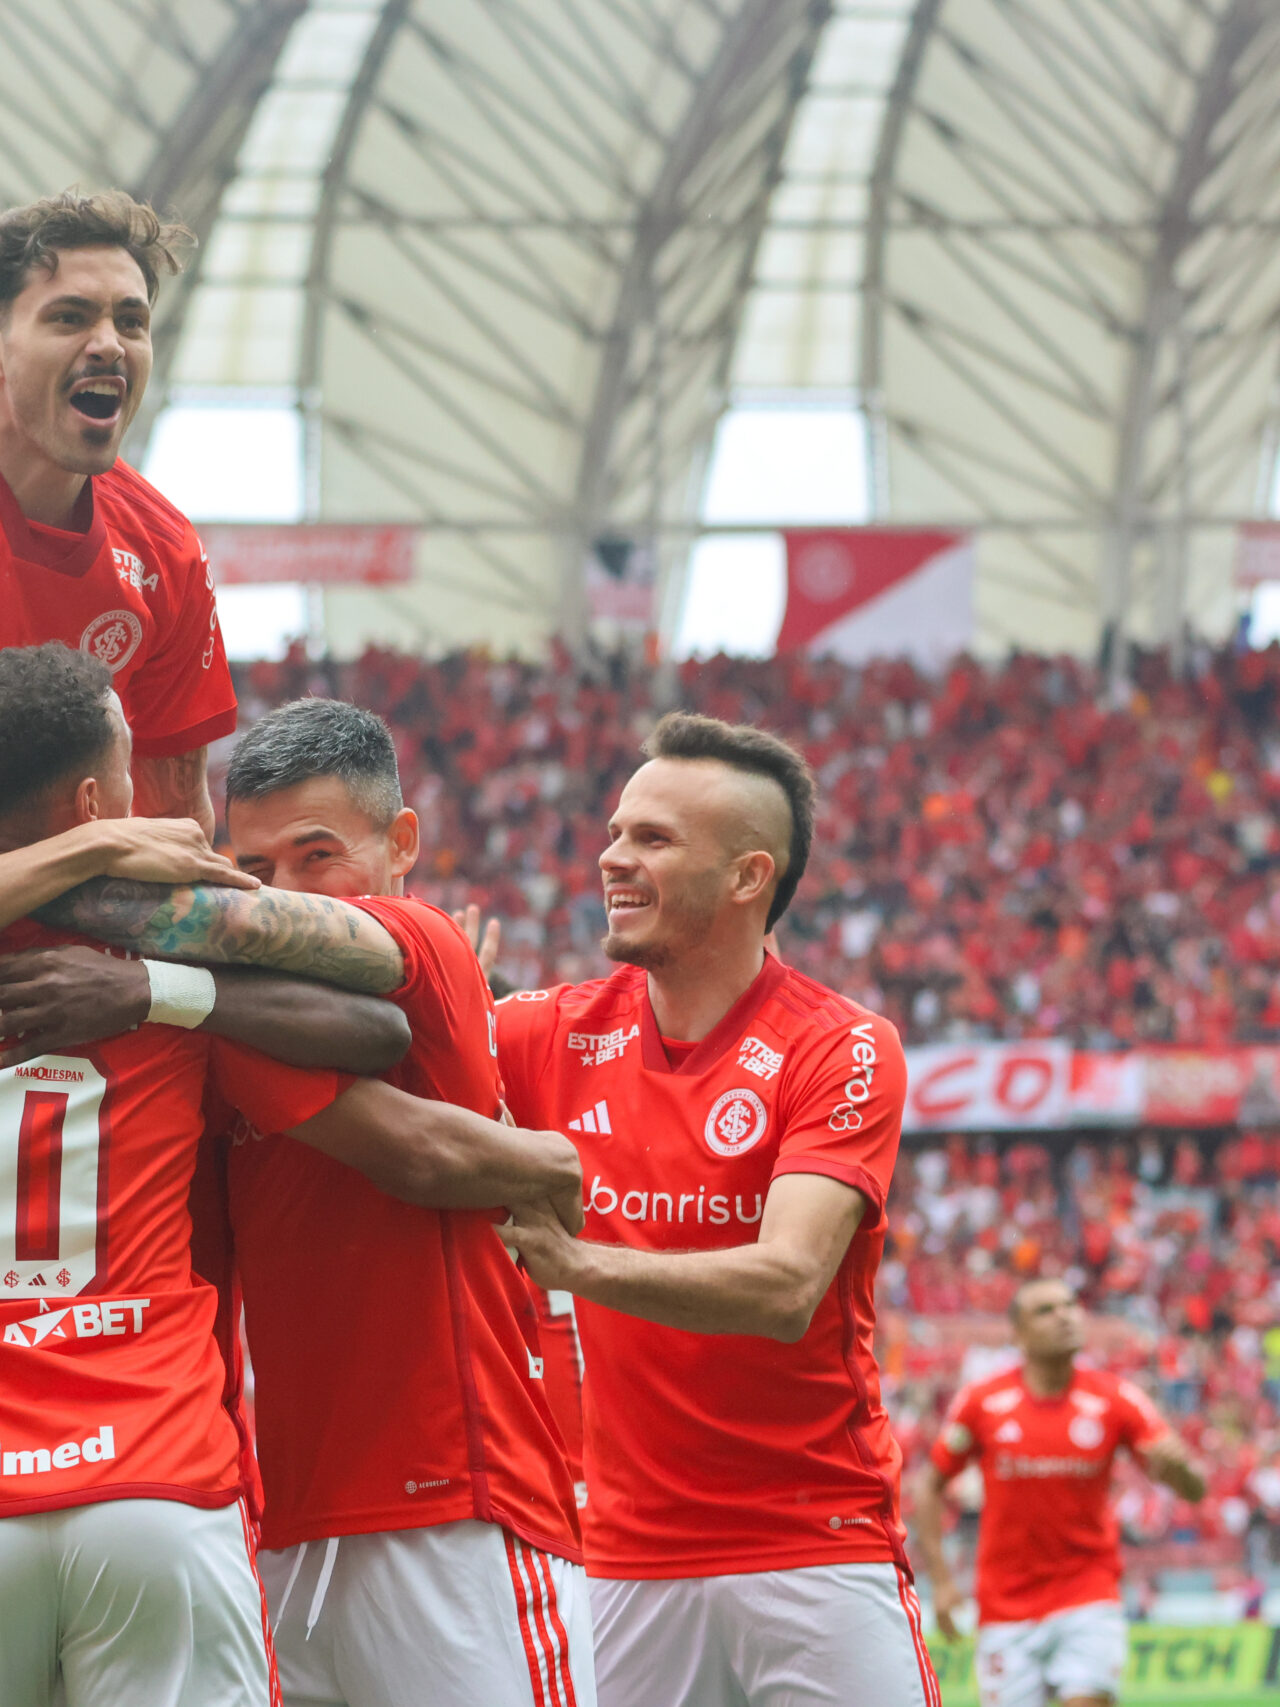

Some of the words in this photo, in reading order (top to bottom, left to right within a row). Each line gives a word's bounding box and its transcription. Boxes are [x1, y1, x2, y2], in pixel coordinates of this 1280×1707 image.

[567, 1023, 640, 1050] ESTRELA
[595, 1041, 628, 1067] BET
[844, 1022, 878, 1102] vero
[14, 1065, 85, 1083] MARQUESPAN
[742, 1055, 780, 1081] BET
[583, 1175, 763, 1226] banrisu
[72, 1298, 151, 1338] BET
